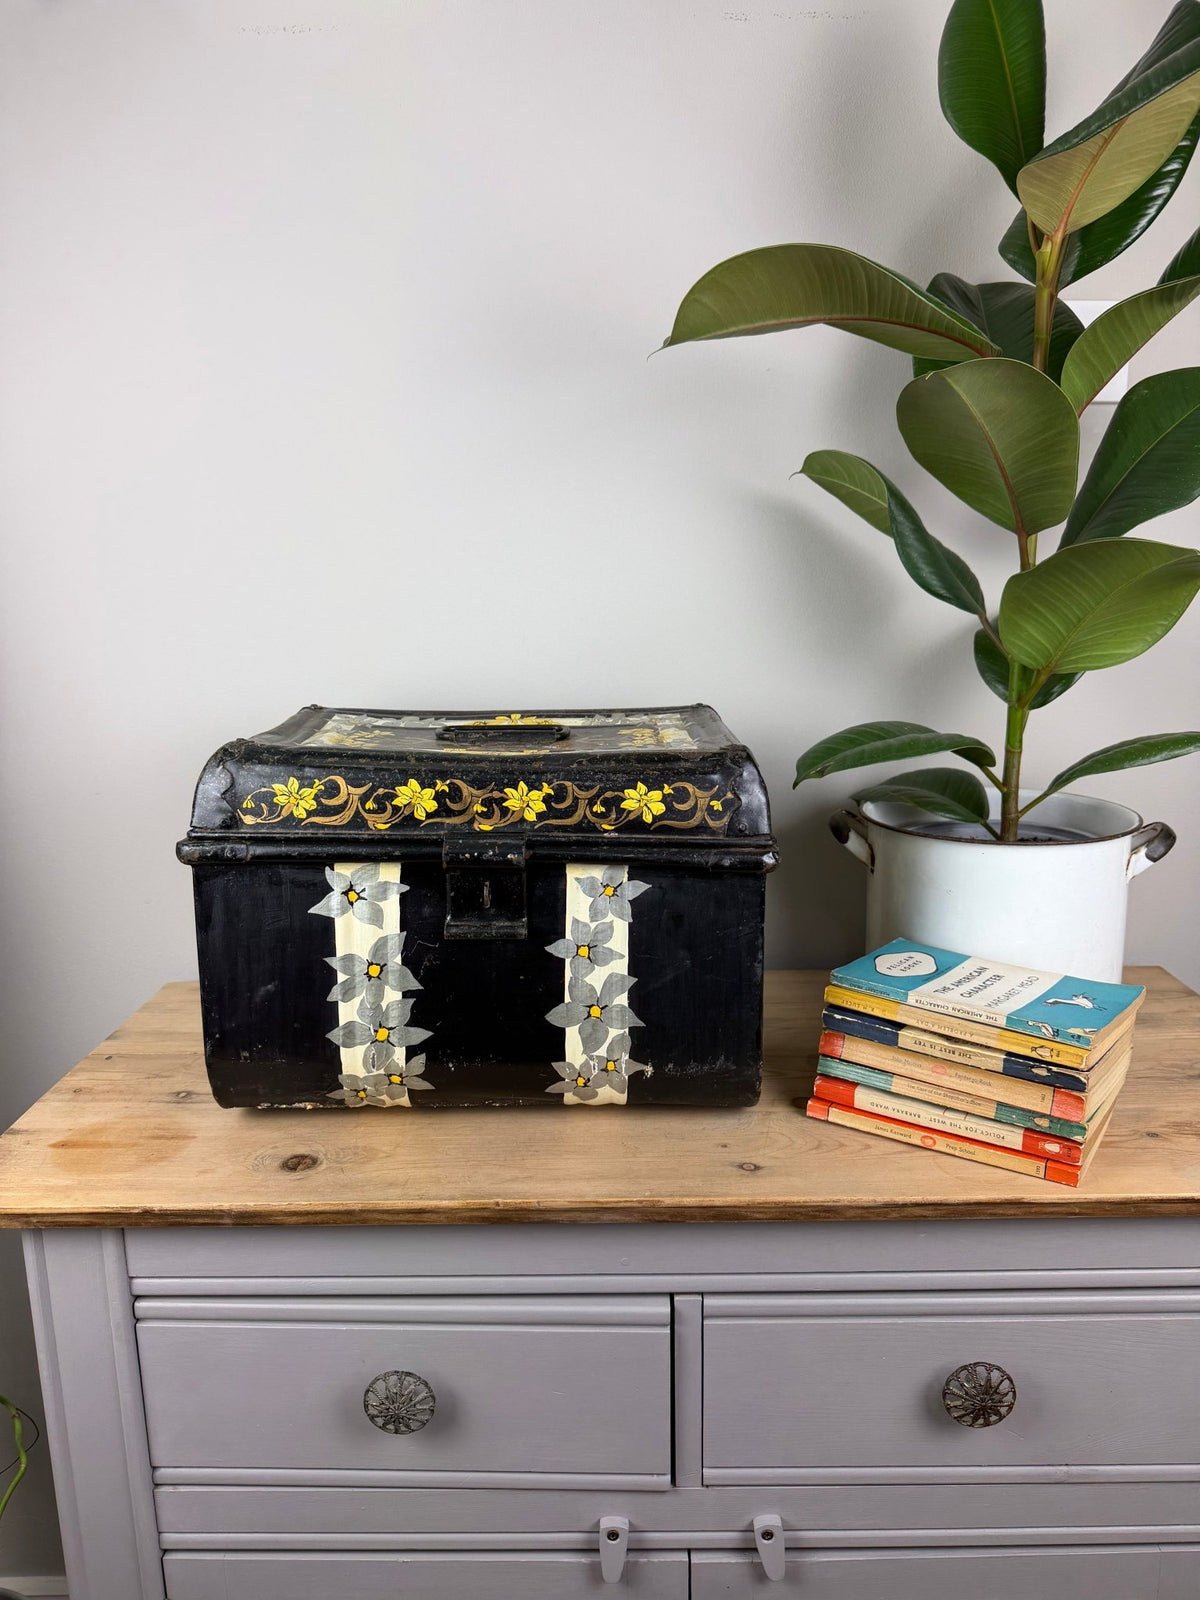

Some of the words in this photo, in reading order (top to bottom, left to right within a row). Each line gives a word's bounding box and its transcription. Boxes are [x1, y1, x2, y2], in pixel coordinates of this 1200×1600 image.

[886, 956, 915, 971] PELICAN
[900, 960, 922, 972] BOOKS
[933, 983, 954, 994] THE
[950, 966, 990, 988] AMERICAN
[960, 974, 1005, 998] CHARACTER
[984, 987, 1020, 1009] MARGARET
[1019, 975, 1040, 990] MEAD
[914, 999, 949, 1010] CHARACTER
[951, 1007, 983, 1018] AMERICAN
[939, 1047, 956, 1055] BEST
[958, 1051, 972, 1059] THE
[870, 1102, 890, 1110] WARD
[892, 1106, 921, 1118] BARBARA
[929, 1116, 946, 1124] WEST
[874, 1124, 889, 1133] James
[965, 1126, 978, 1134] FOR
[980, 1129, 1005, 1140] POLICY
[945, 1143, 959, 1152] Prep
[958, 1147, 976, 1156] School
